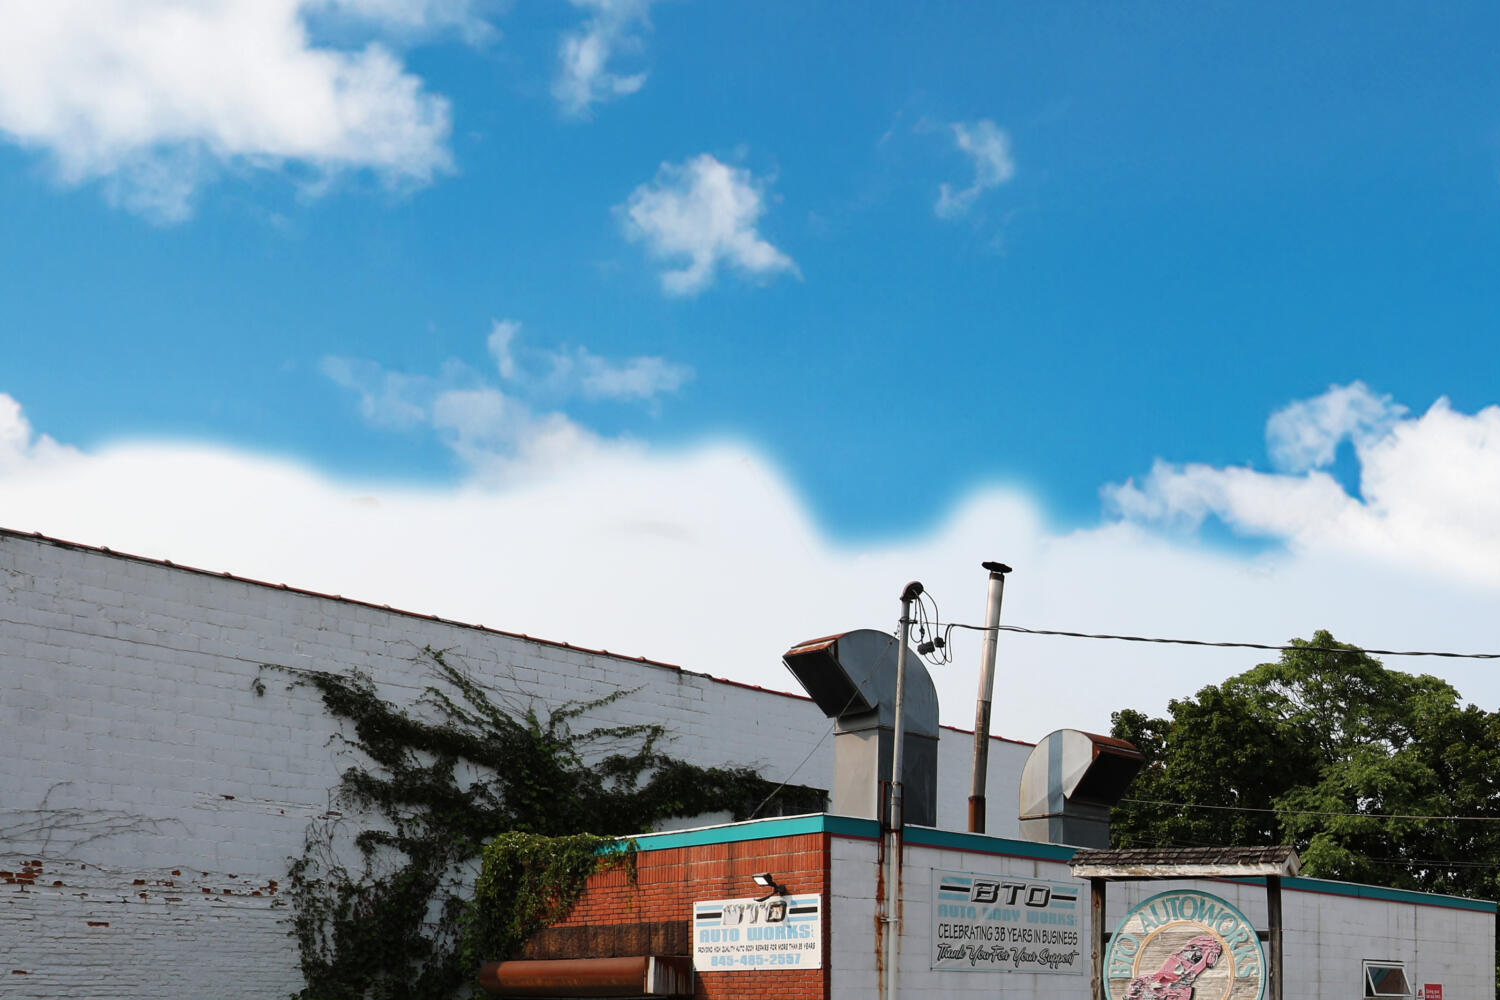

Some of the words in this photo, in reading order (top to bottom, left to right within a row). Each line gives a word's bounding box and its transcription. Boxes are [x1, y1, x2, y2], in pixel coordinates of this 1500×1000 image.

[971, 879, 1050, 908] BTO
[938, 904, 976, 920] AUTO
[1026, 911, 1075, 926] WORKS
[700, 928, 740, 943] AUTO
[747, 925, 810, 941] WORKS
[938, 923, 992, 941] CELEBRATING
[1007, 928, 1033, 943] YEARS
[1034, 929, 1041, 943] IN
[1042, 930, 1078, 945] BUSINESS
[1110, 934, 1140, 978] BTO
[1138, 896, 1259, 978] AUTOWORKS
[937, 943, 966, 961] Thank
[966, 944, 991, 966] You
[991, 945, 1010, 963] For
[1010, 946, 1038, 968] Your
[1038, 948, 1079, 969] Support
